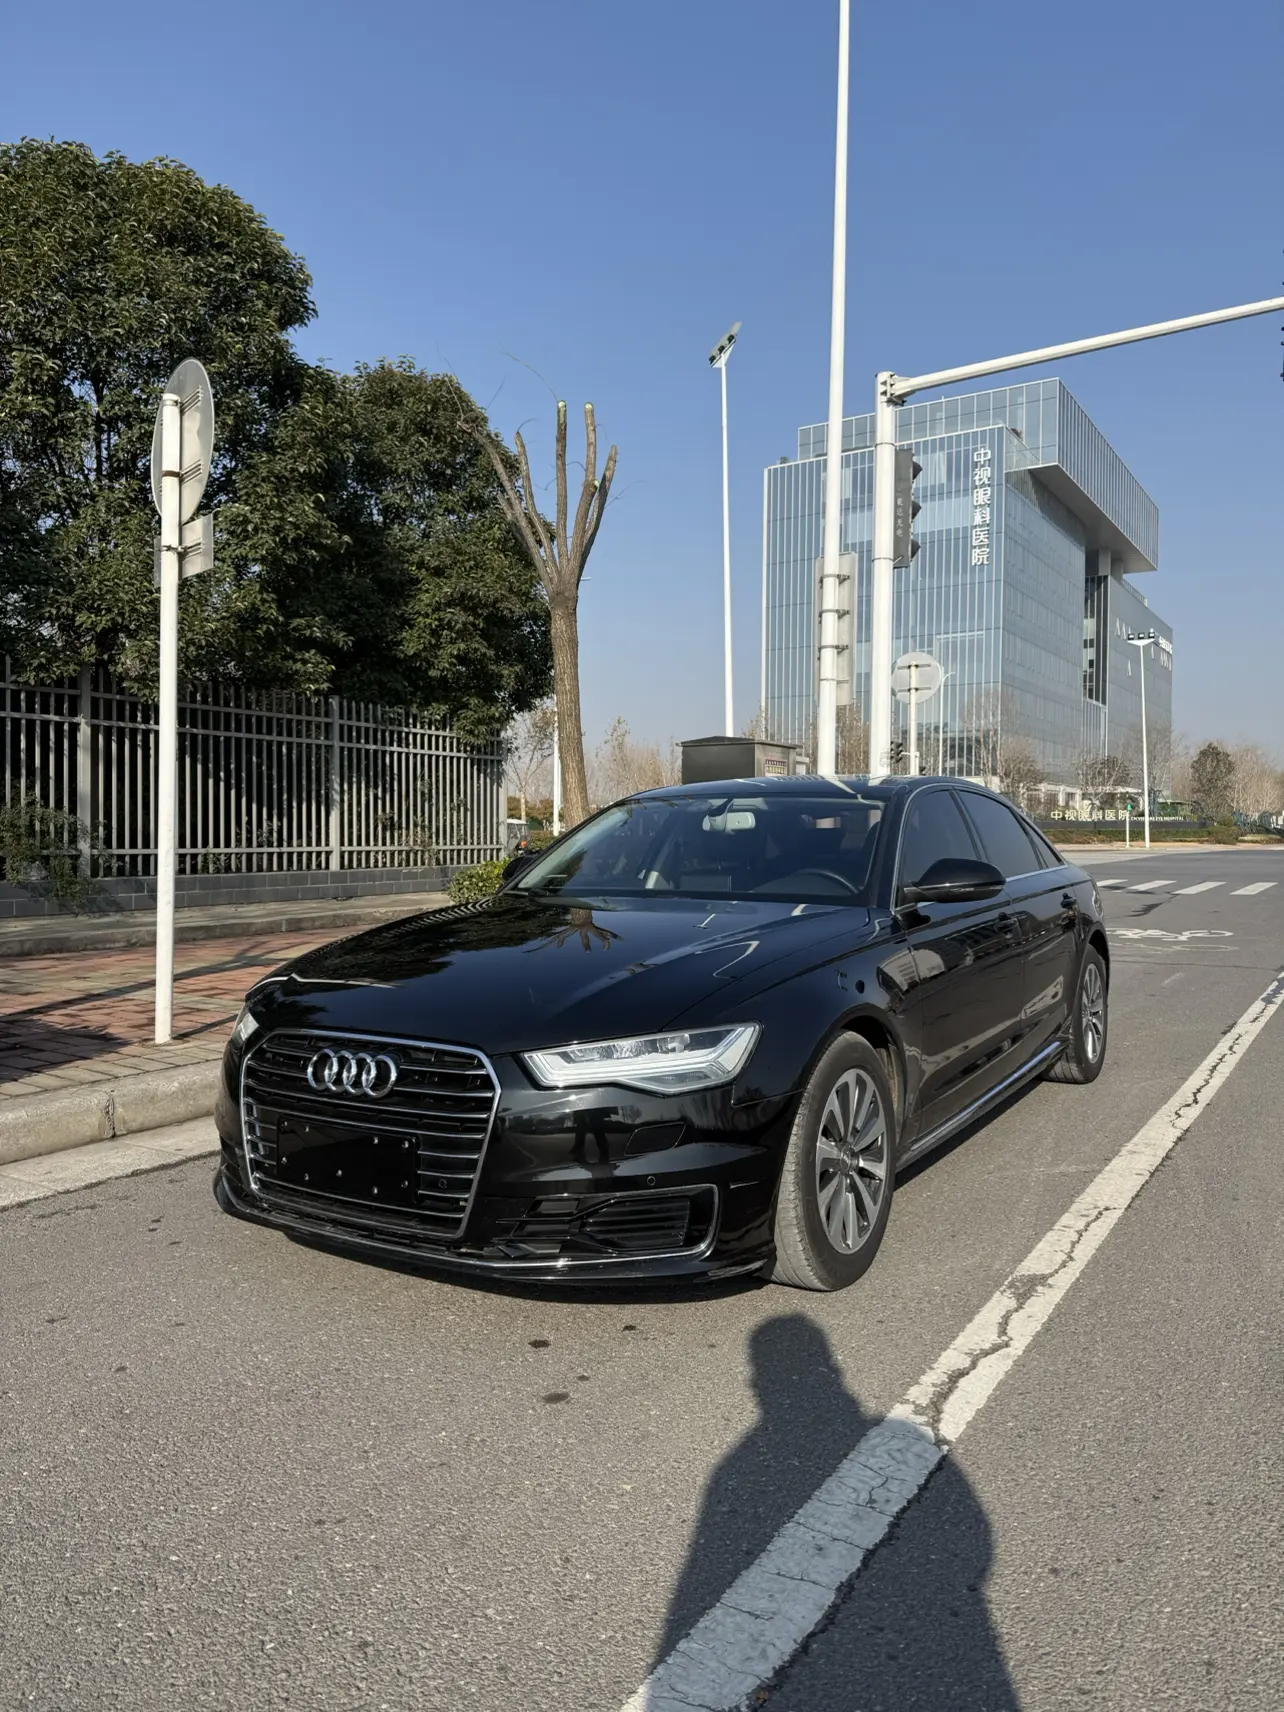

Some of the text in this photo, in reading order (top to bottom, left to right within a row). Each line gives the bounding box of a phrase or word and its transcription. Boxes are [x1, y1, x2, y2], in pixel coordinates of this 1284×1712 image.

[972, 447, 992, 566] 中视眼科医院
